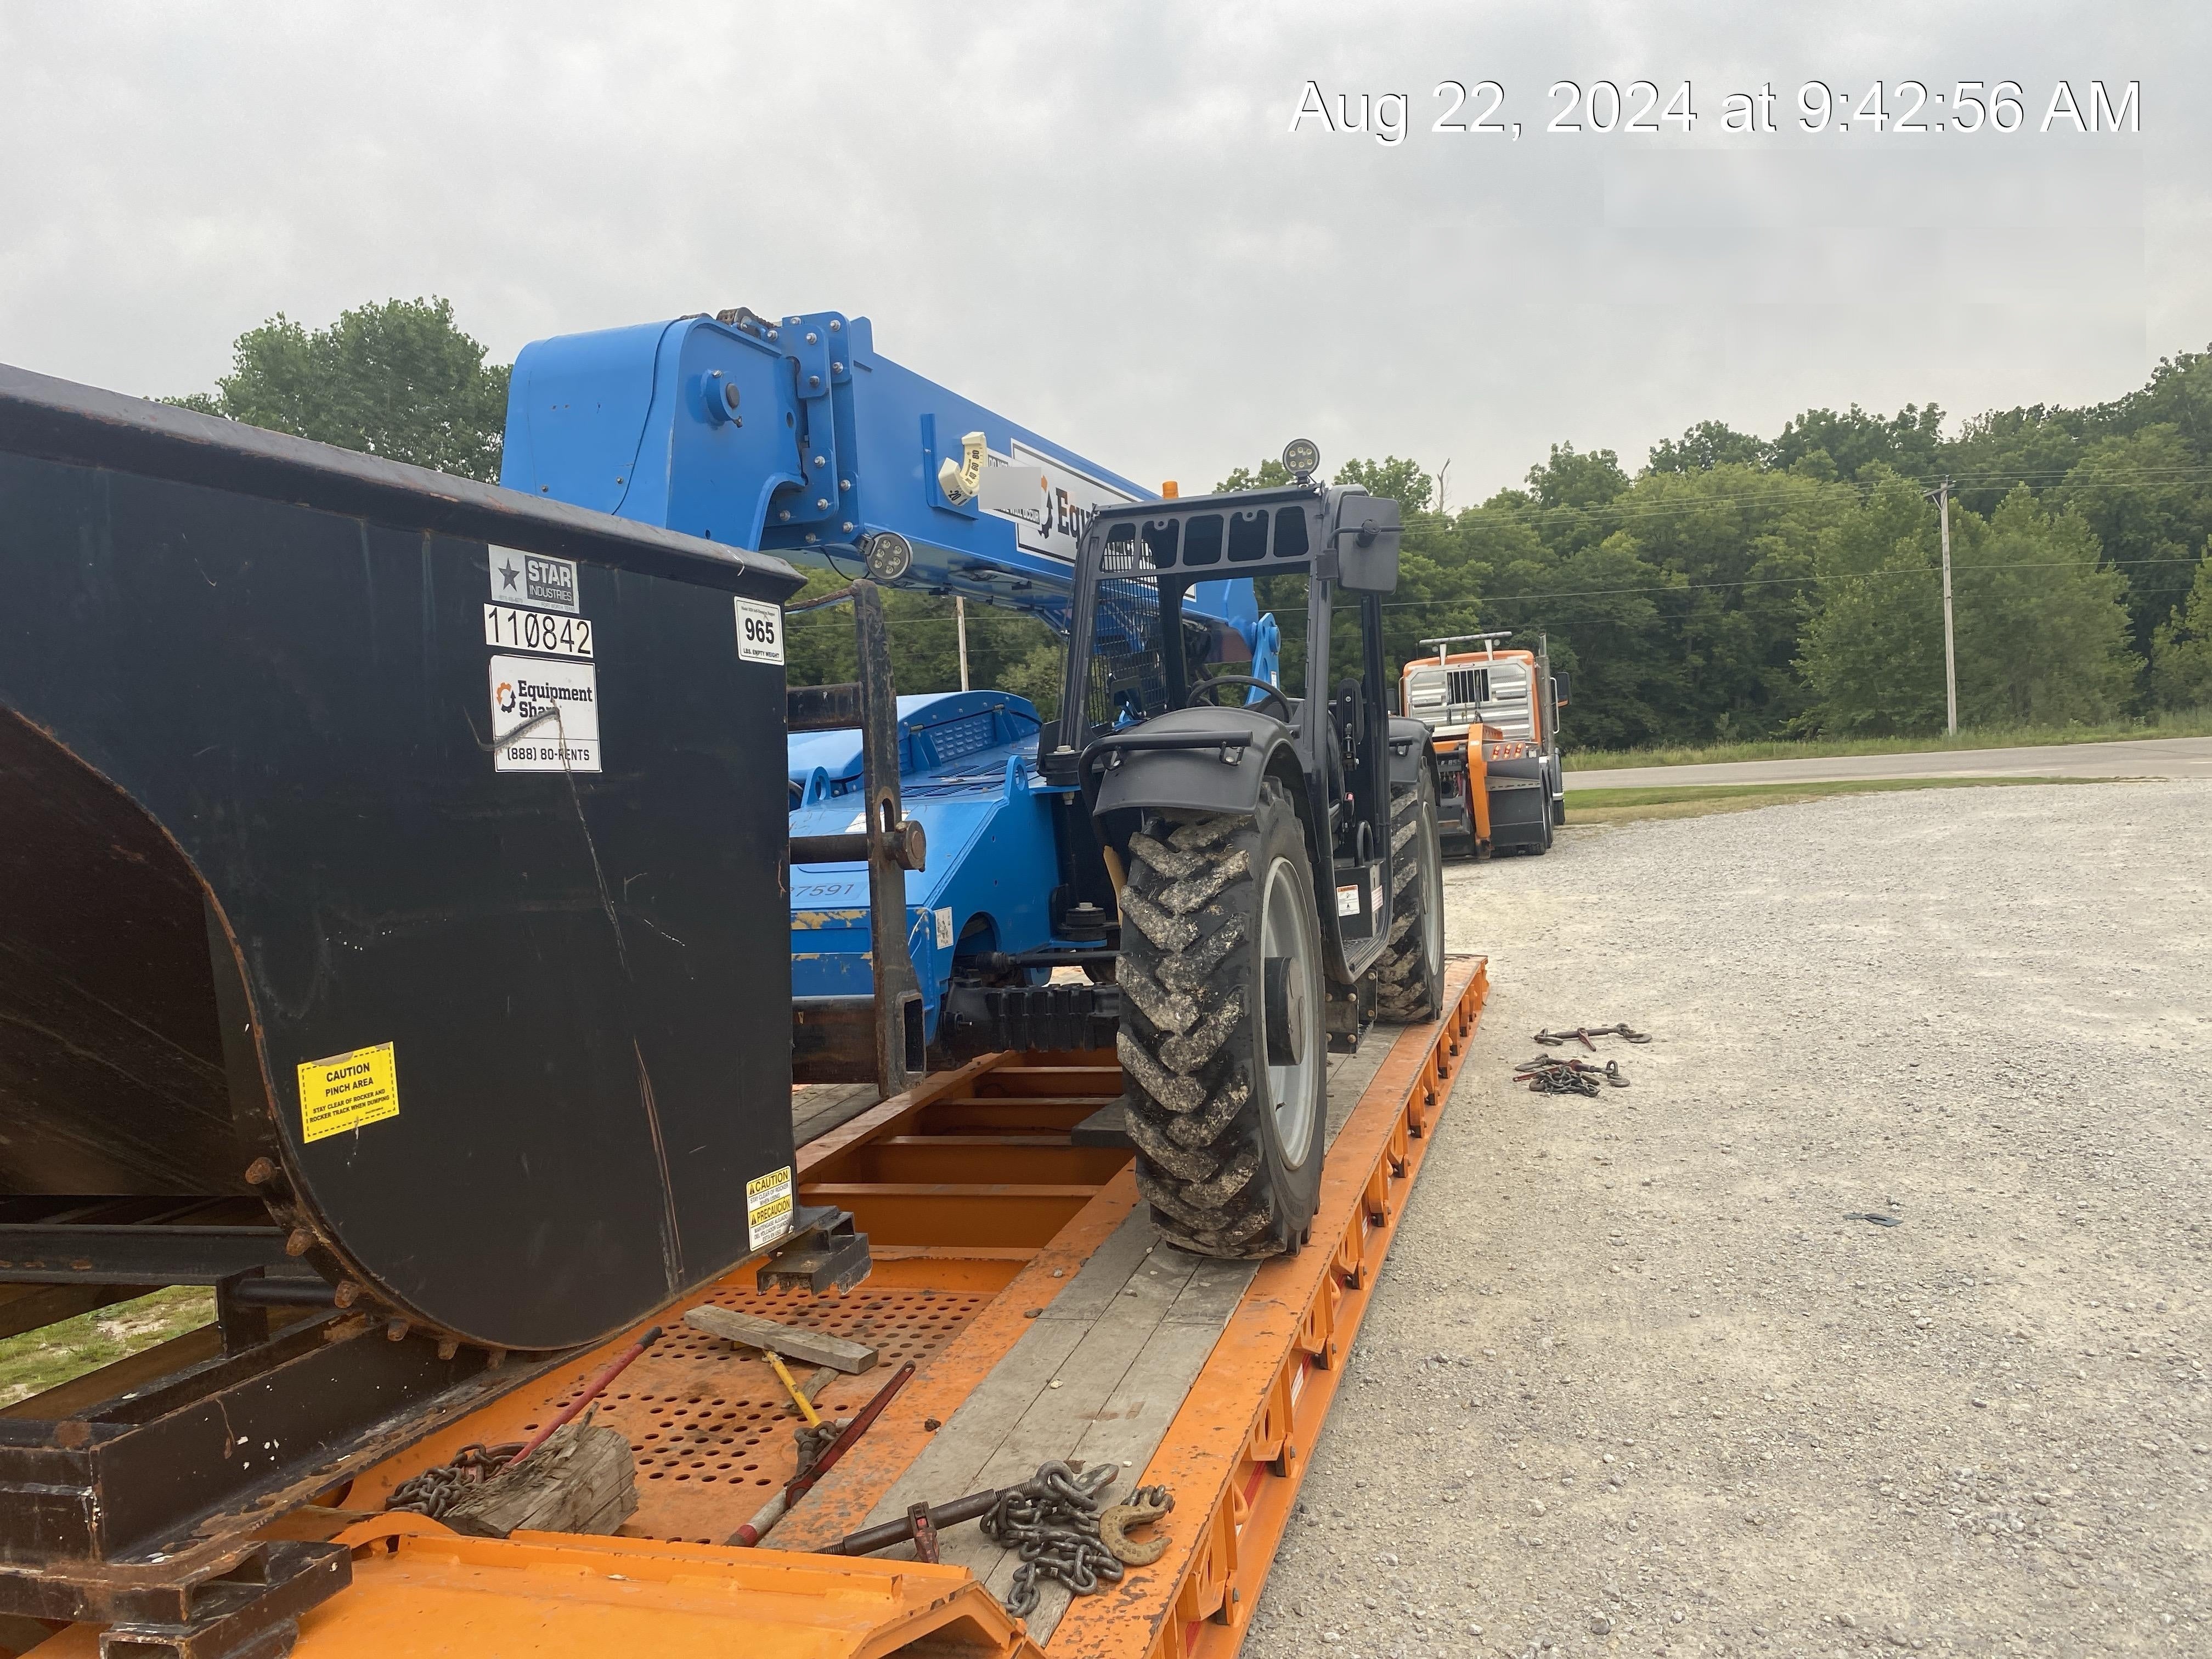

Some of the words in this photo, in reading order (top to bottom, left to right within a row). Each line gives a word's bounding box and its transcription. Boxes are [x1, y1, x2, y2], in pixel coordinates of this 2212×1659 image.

[972, 450, 979, 459] 80
[972, 462, 979, 471] 60
[528, 560, 572, 588] STAR
[529, 585, 572, 601] INDUSTRIES
[488, 607, 591, 654] 110842
[745, 618, 774, 644] 965
[518, 680, 592, 702] Equipment
[507, 747, 537, 760] (888)
[540, 748, 590, 761] 80-RENTS
[326, 1062, 370, 1082] CAUTION
[325, 1083, 350, 1097] PINCH
[352, 1077, 374, 1090] AREA
[310, 1112, 332, 1123] ROCKER
[332, 1107, 350, 1116] TRACK
[351, 1102, 366, 1110] WHEN
[367, 1095, 390, 1106] DUMPING
[313, 1105, 326, 1114] STAY
[328, 1101, 344, 1109] CLEAR
[353, 1092, 374, 1102] ROCKER
[755, 1170, 788, 1192] CAUTION
[759, 1190, 770, 1200] CLEAR
[757, 1197, 790, 1223] PRECAUCIÓN
